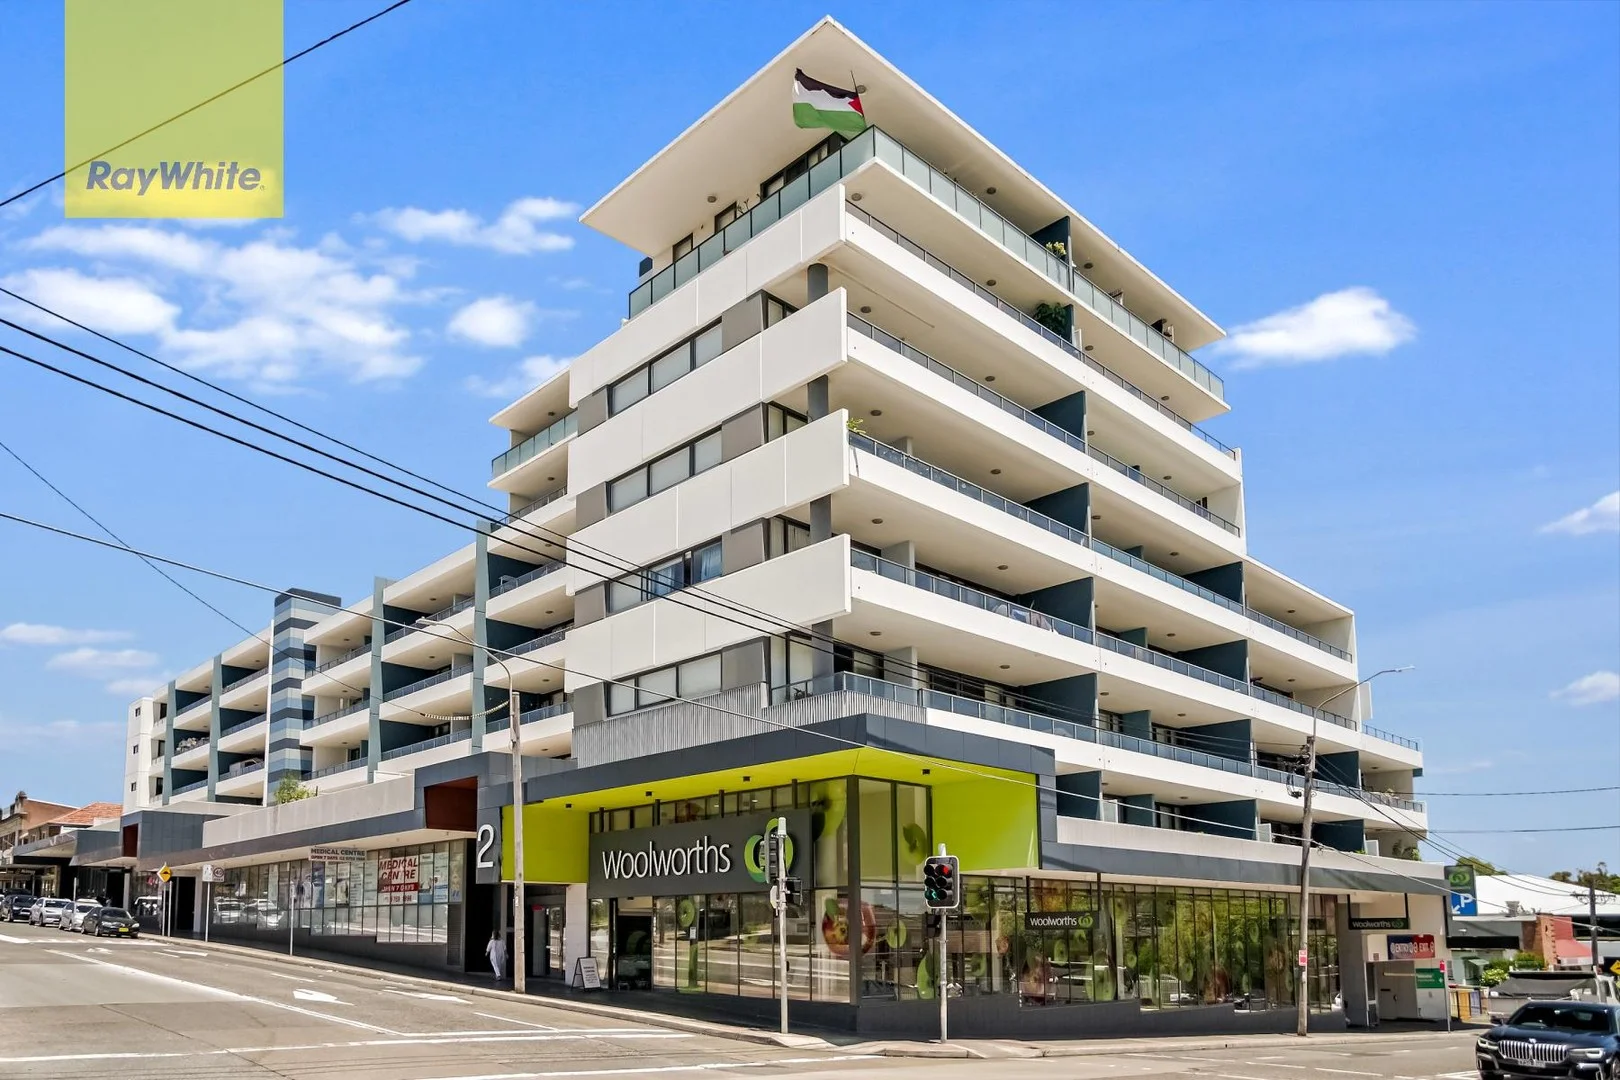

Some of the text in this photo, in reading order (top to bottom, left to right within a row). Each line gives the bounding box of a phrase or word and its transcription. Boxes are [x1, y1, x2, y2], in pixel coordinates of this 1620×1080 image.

[340, 849, 365, 857] CENTRE
[477, 824, 494, 868] 2
[379, 857, 418, 870] MEDICAL
[602, 836, 731, 879] Woolworths
[381, 869, 416, 880] CENRE
[1460, 893, 1473, 908] P
